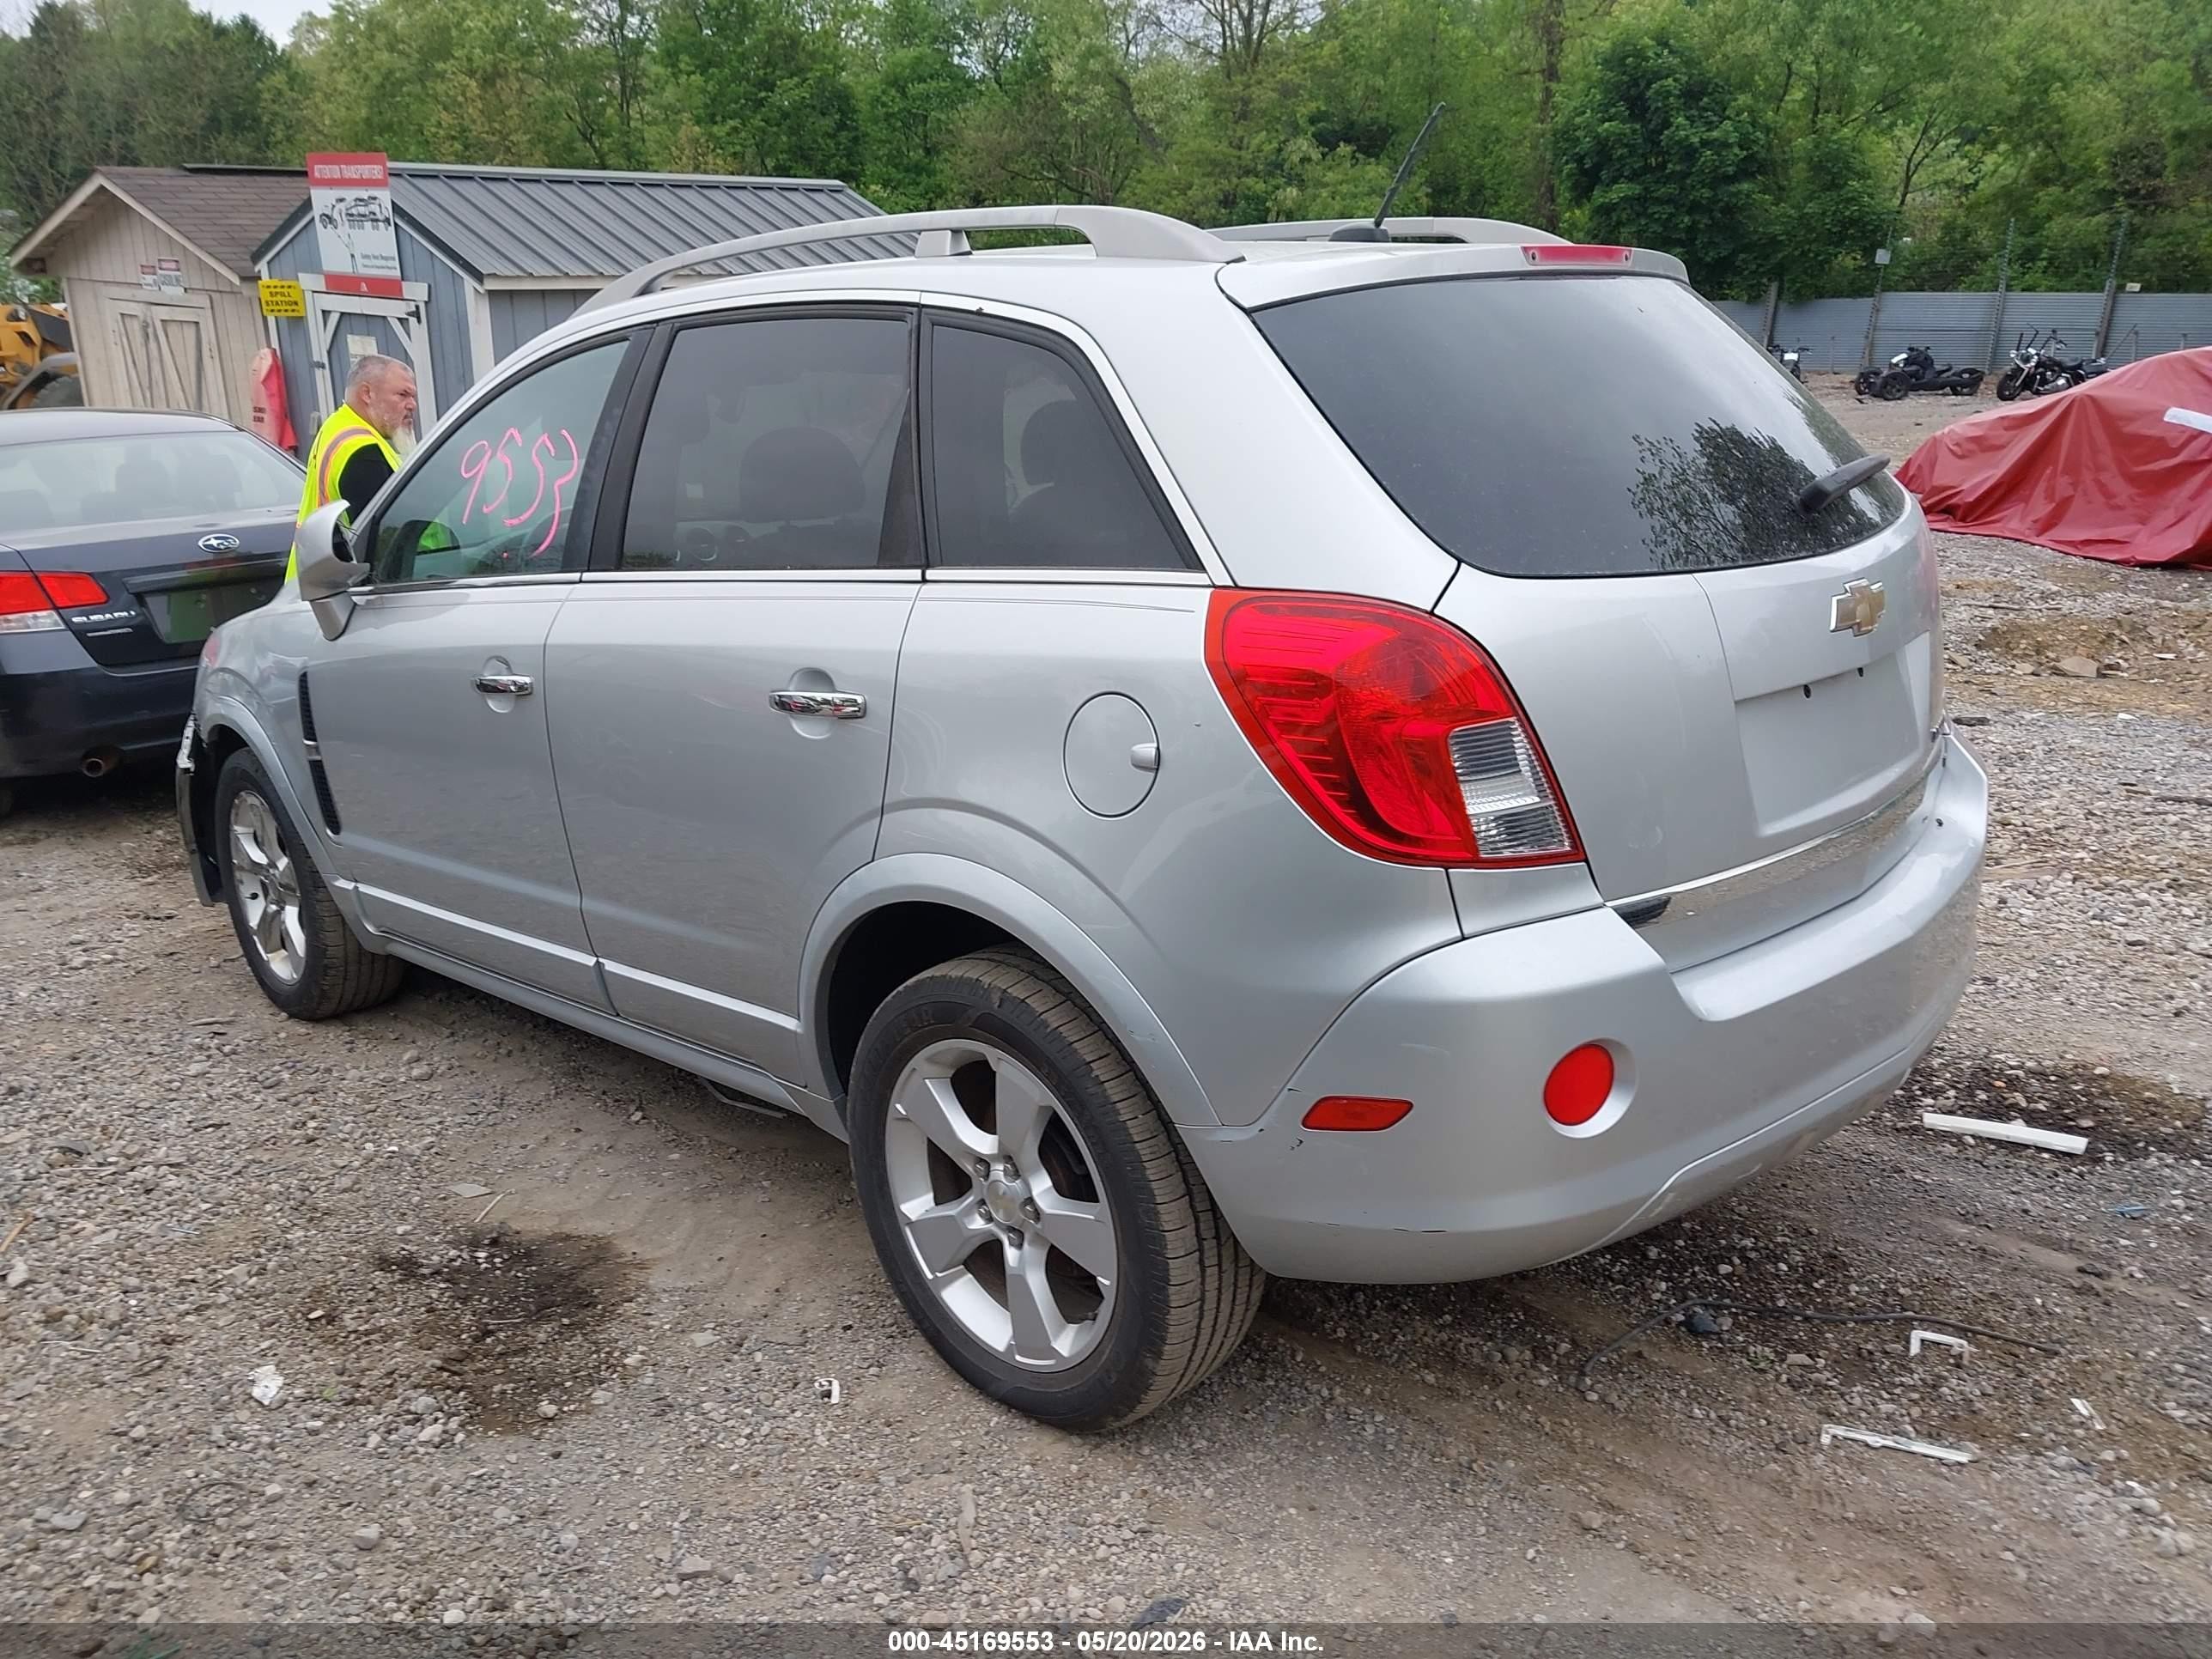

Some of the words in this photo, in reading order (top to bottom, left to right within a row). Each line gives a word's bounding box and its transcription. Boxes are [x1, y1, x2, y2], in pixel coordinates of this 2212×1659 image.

[314, 164, 342, 179] ATTENTION
[460, 427, 579, 558] 9553
[70, 611, 137, 624] SUBARU
